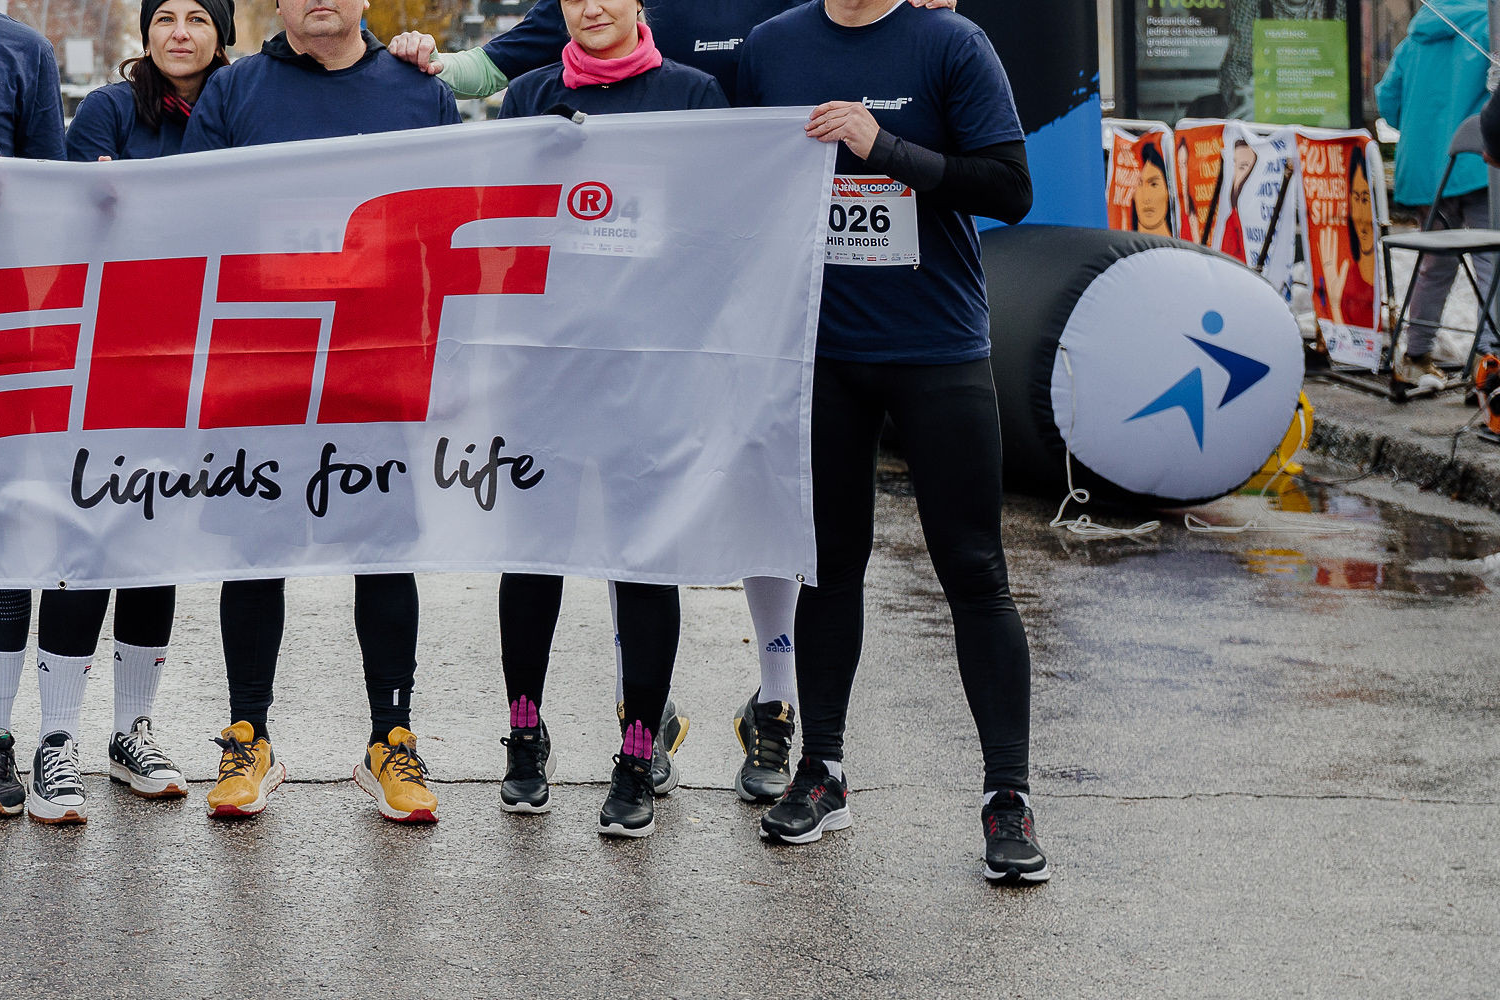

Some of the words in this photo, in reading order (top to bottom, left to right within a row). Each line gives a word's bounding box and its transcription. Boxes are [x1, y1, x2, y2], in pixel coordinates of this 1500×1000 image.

[860, 183, 902, 193] SLOBODU
[828, 203, 891, 234] 026
[827, 236, 845, 247] HIR
[847, 235, 890, 248] DROBIĆ
[71, 448, 282, 521] Liquids
[306, 442, 408, 518] for
[434, 435, 546, 512] life
